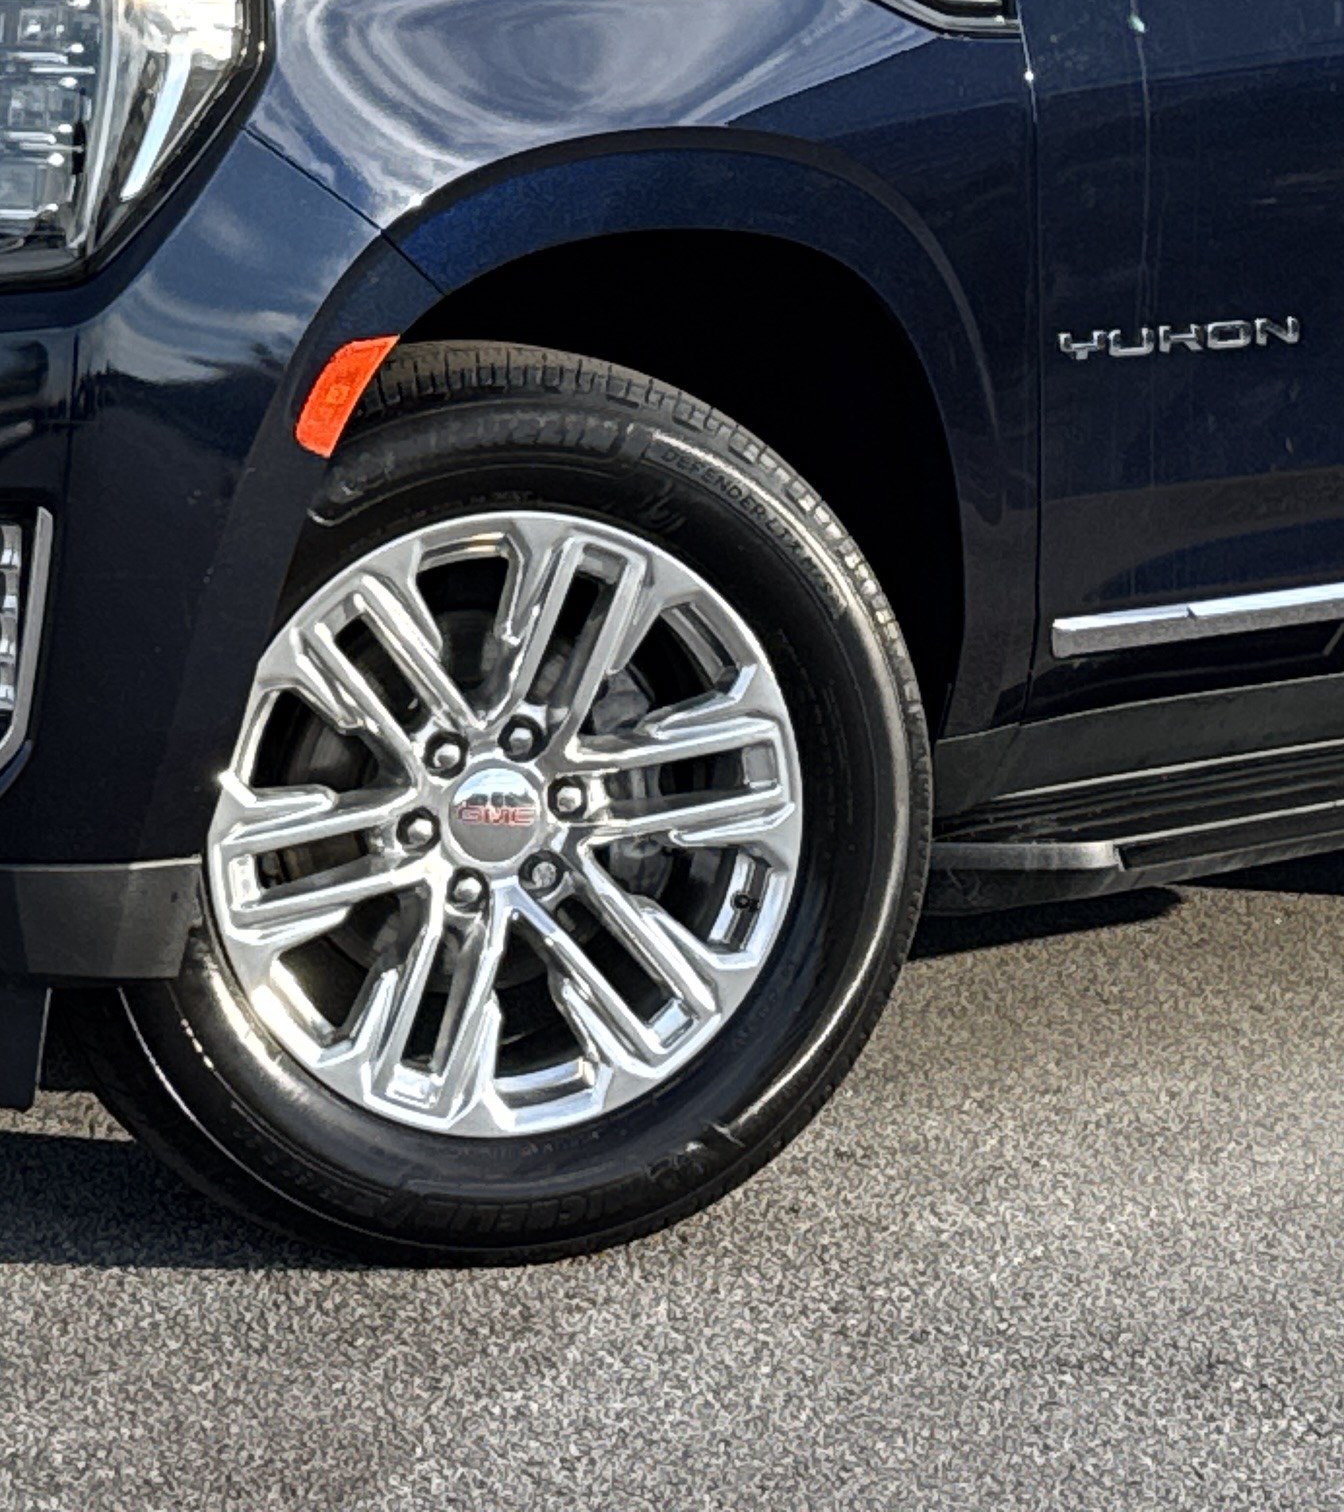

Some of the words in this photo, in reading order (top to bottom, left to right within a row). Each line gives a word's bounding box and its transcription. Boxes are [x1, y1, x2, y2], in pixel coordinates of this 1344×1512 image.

[1057, 315, 1301, 361] YUKON
[661, 449, 767, 523] DEFENDER
[458, 803, 535, 827] GMC
